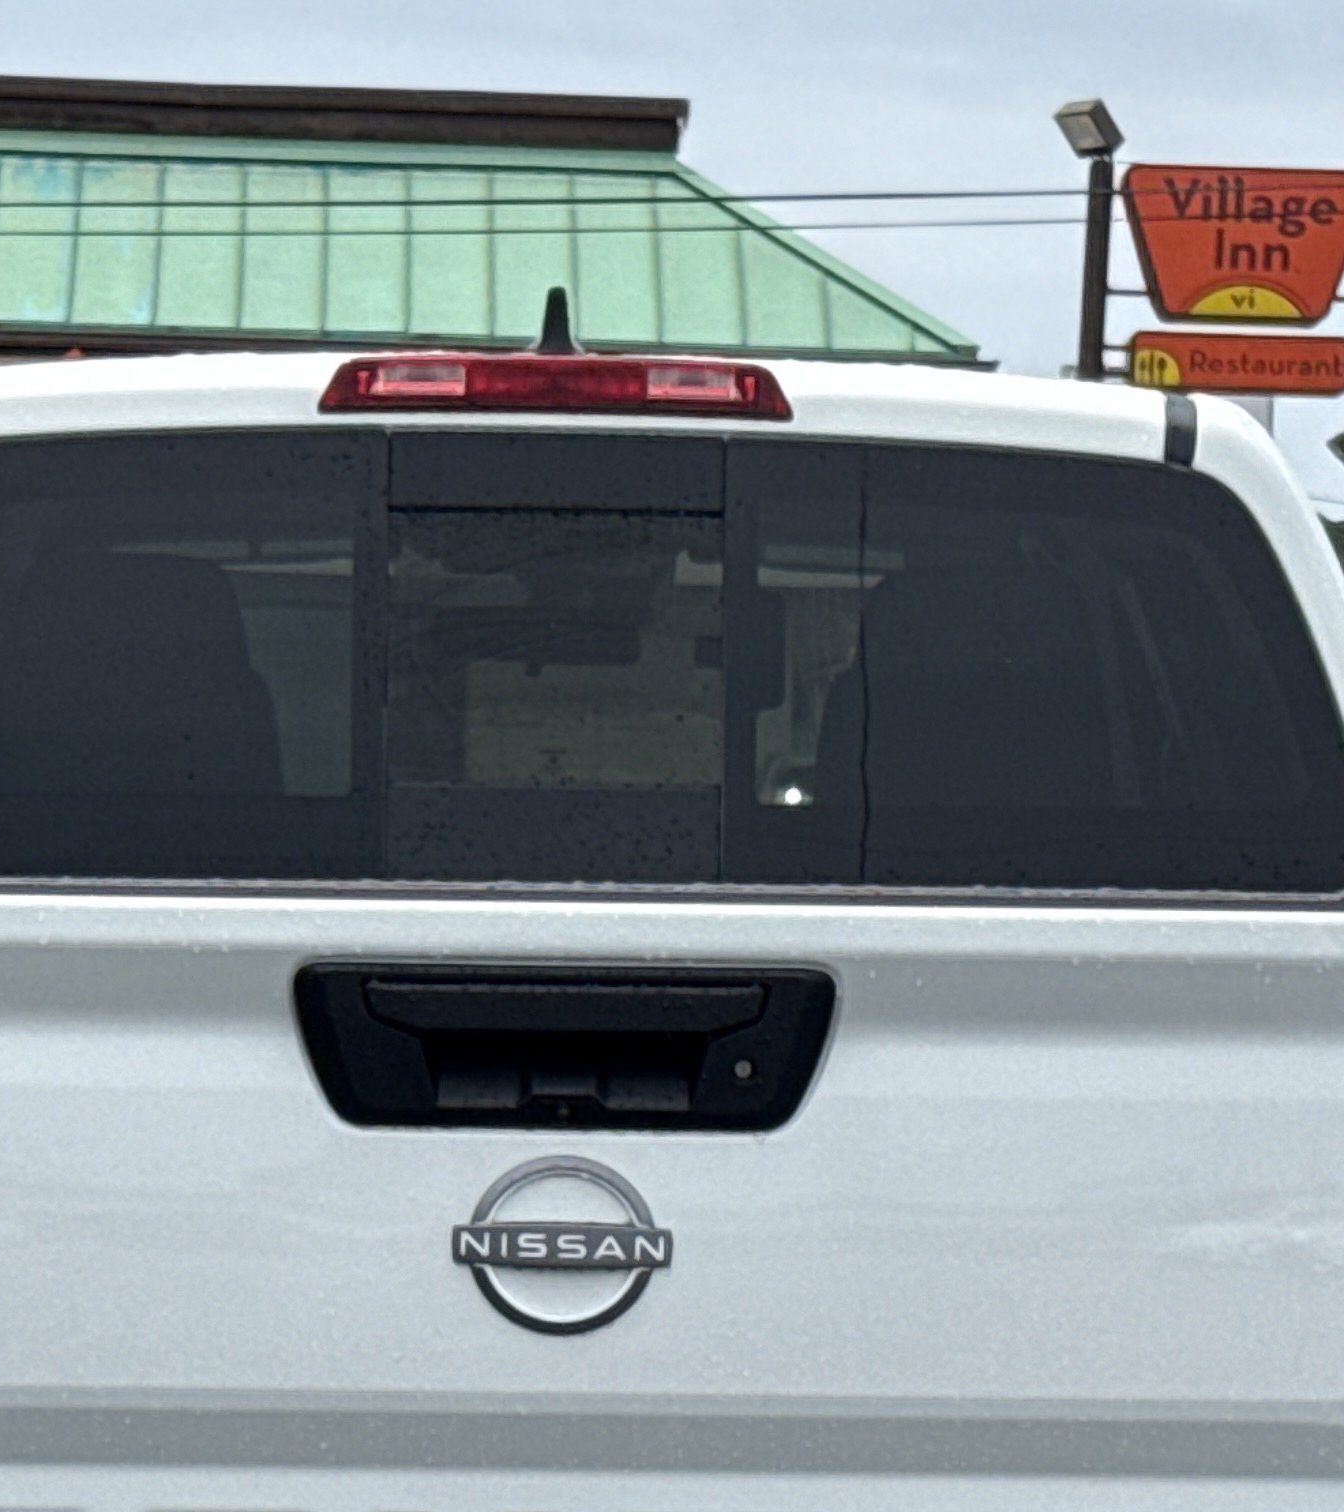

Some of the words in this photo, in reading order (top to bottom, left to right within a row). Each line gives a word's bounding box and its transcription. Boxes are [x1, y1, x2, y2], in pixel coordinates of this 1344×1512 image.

[1164, 176, 1339, 237] Village
[1214, 228, 1291, 272] Inn
[1229, 287, 1256, 310] vi
[1189, 350, 1344, 377] Restaurant
[459, 1231, 665, 1261] NISSAN
